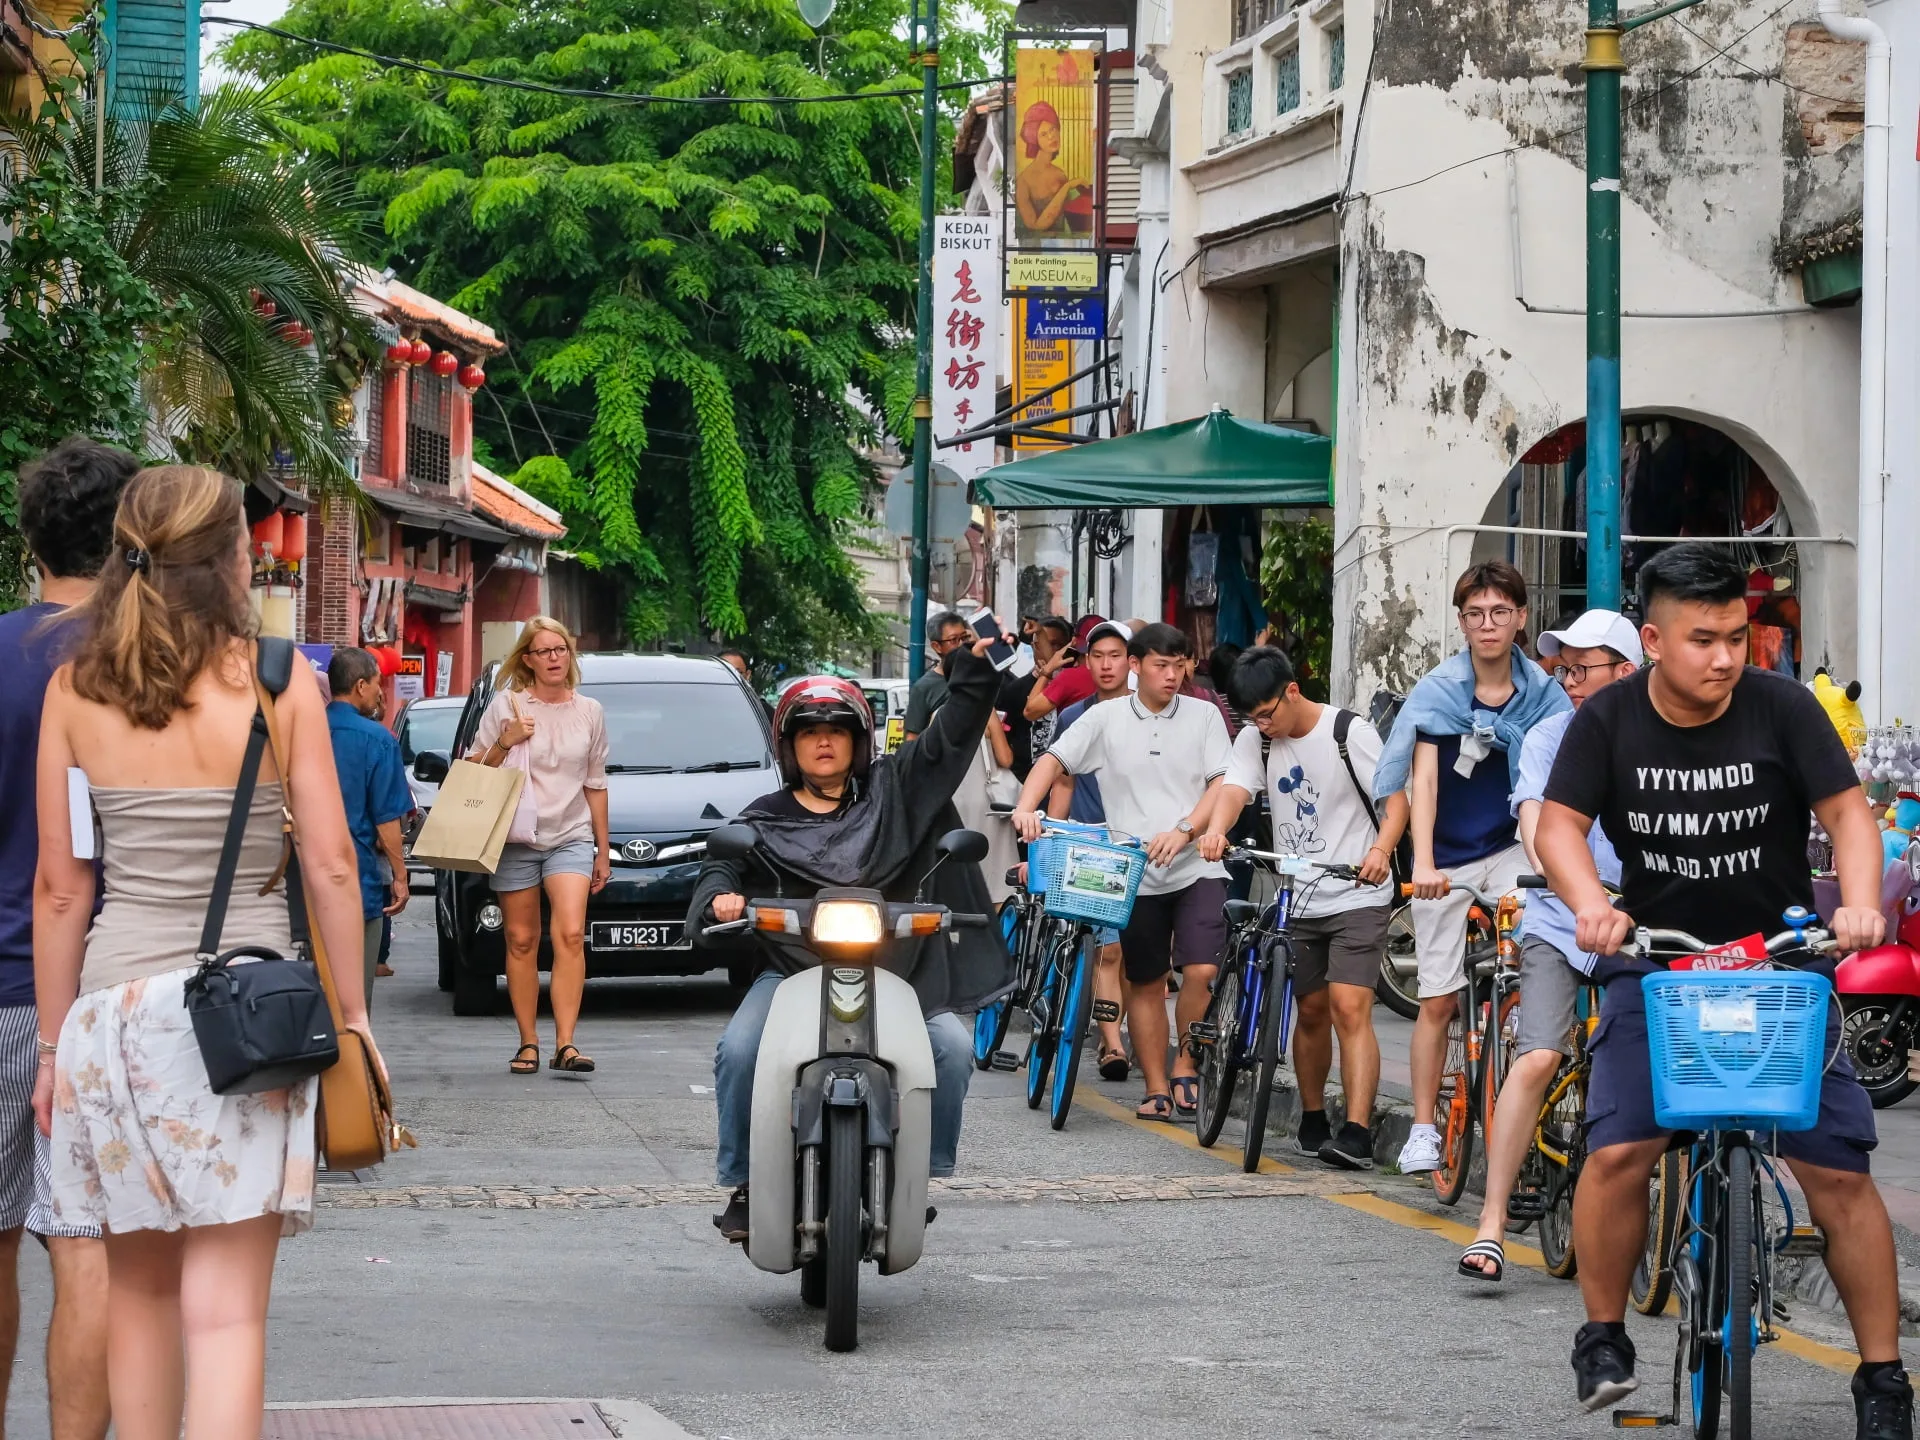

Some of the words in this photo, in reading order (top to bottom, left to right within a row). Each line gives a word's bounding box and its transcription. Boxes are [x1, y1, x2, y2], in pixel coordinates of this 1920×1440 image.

[945, 222, 988, 235] KEDAI
[940, 237, 992, 251] BISKUT
[1013, 257, 1033, 265] Batik
[1035, 257, 1067, 267] Painting
[1019, 269, 1078, 282] MUSEUM
[1033, 322, 1096, 336] Armenian
[1024, 350, 1064, 361] HOWARD
[1636, 763, 1754, 792] YYYYMMDD
[1627, 803, 1770, 836] DD/MM/YYYY
[1642, 846, 1761, 880] MM.DD.YYYY
